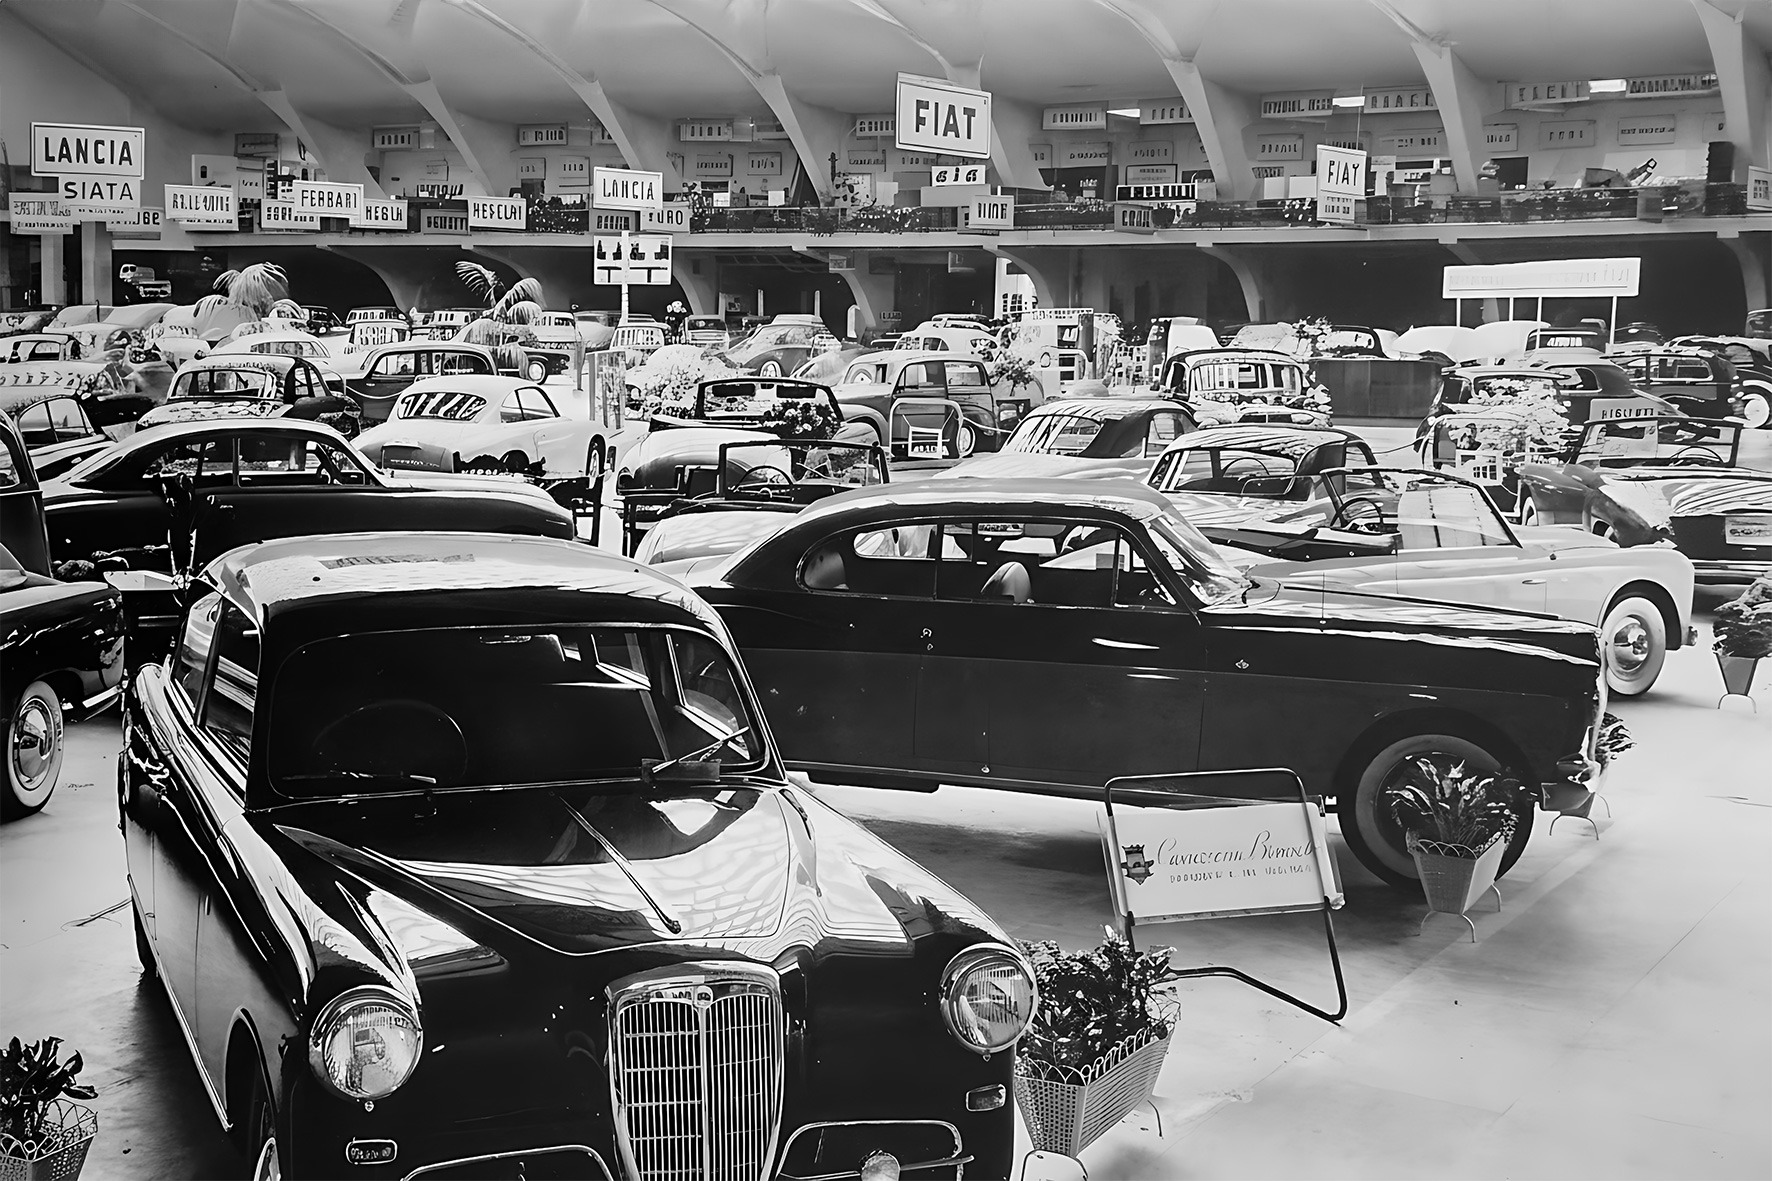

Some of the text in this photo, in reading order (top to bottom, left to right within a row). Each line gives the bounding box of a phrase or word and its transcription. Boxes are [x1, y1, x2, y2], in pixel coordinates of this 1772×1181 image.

[915, 98, 976, 140] FIAT
[44, 136, 133, 166] LANCIA
[64, 181, 134, 201] SIATA
